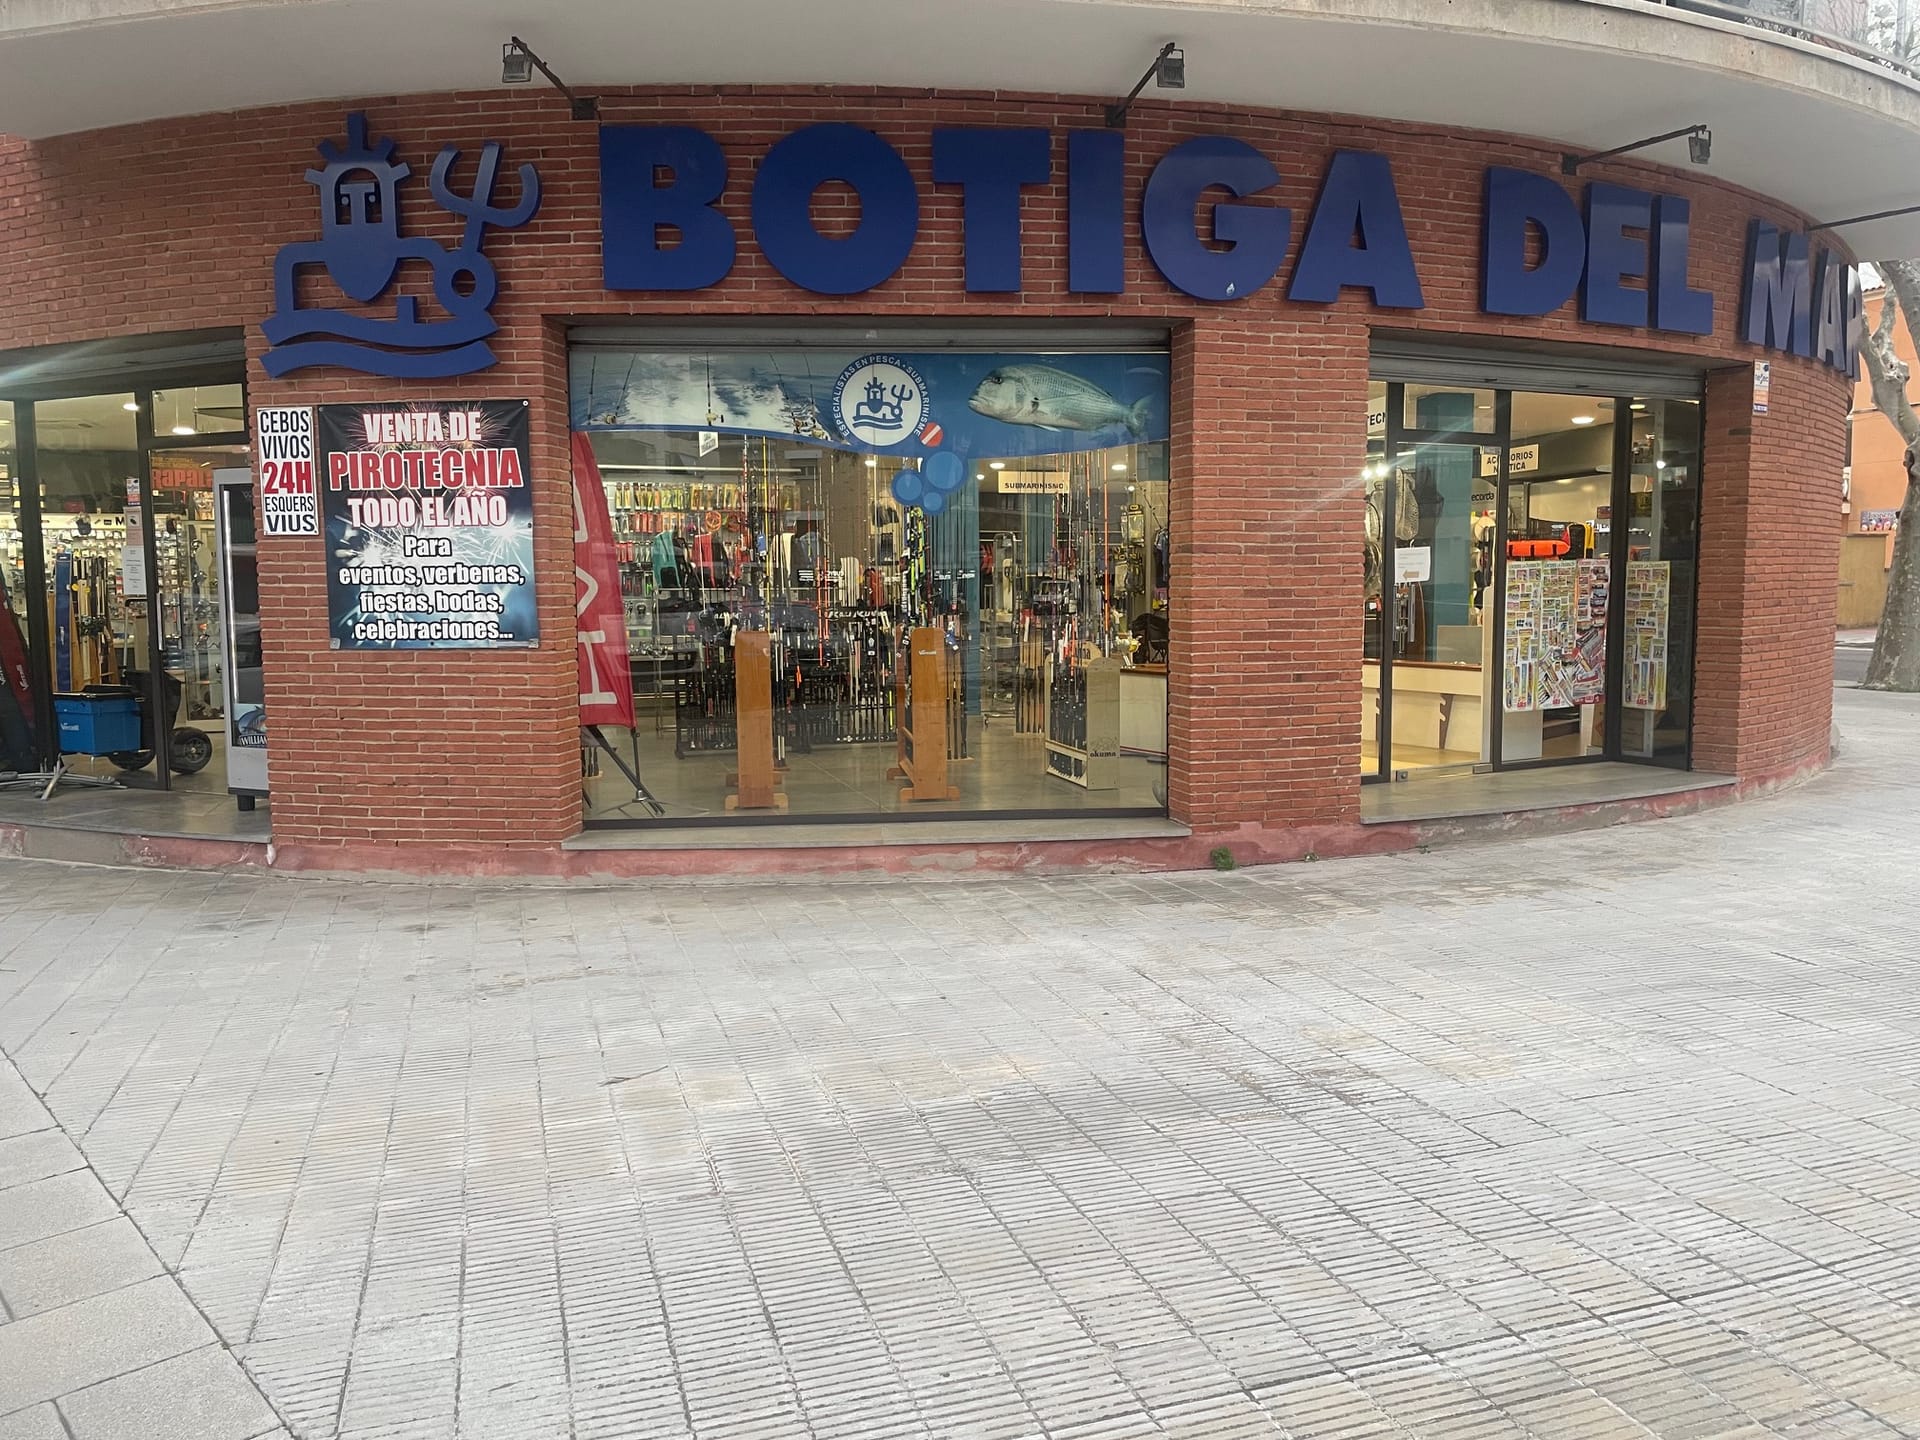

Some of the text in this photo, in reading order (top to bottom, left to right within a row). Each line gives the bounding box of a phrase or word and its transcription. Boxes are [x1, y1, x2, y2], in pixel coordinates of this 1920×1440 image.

[600, 122, 1424, 309] BOTIGA
[1482, 166, 1714, 336] DEL
[832, 355, 930, 437] ESPECIALISTAS EN PESCA SUBMARINISME
[260, 410, 310, 433] CEBOS
[363, 411, 482, 443] VENTA DE
[261, 435, 310, 459] VIVOS
[263, 461, 313, 495] 24H
[329, 448, 524, 491] PIROTECNIA
[1004, 482, 1064, 490] SUBMARINISMO
[265, 495, 315, 513] ESQUERS
[347, 490, 508, 528] TODO EL AÑO
[266, 514, 316, 533] VIUS
[404, 535, 452, 557] Para
[339, 563, 525, 587] eventos, verbenas,
[359, 590, 504, 614] fiestas, bodas,
[354, 619, 513, 640] celebraciones...
